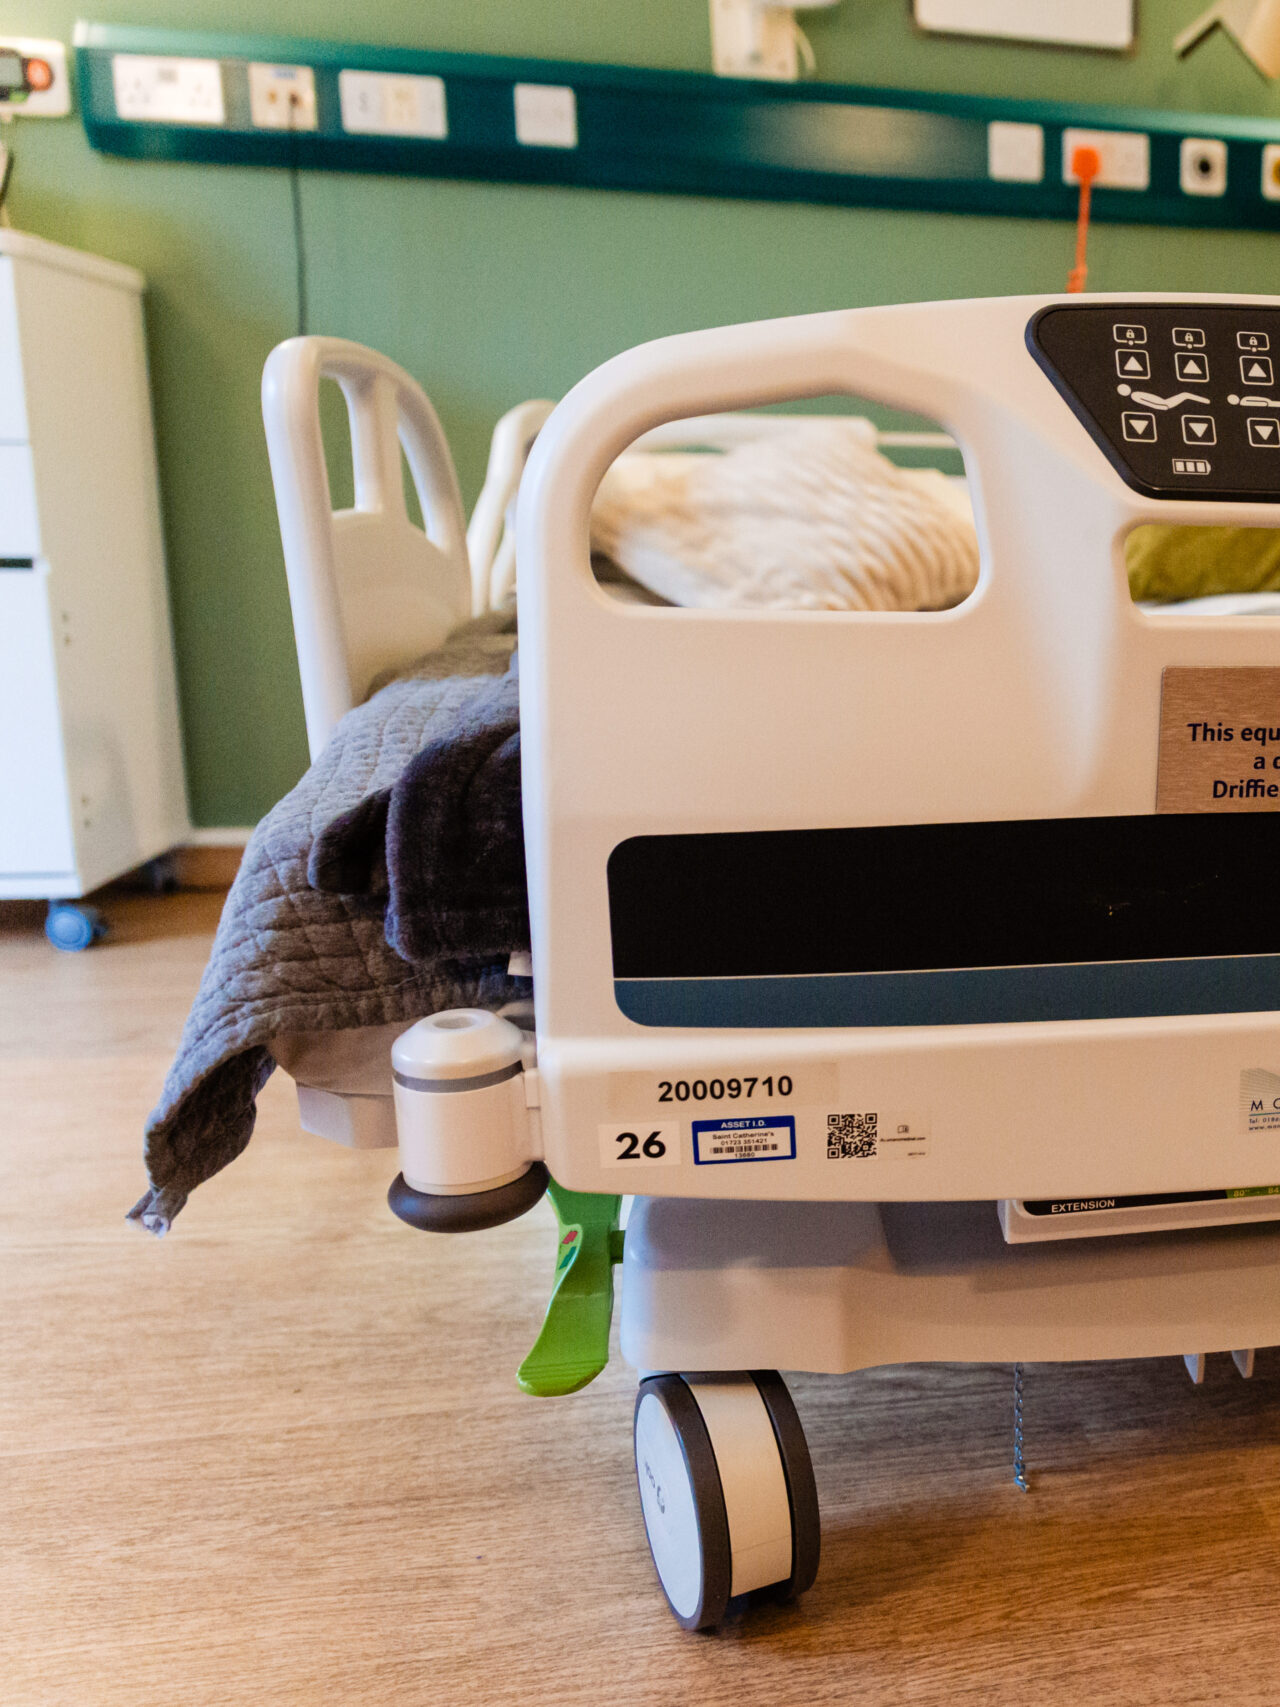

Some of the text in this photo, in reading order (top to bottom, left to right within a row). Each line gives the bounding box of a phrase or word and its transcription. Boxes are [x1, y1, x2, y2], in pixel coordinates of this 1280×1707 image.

[1187, 722, 1234, 742] This
[1253, 754, 1266, 770] a
[657, 1075, 794, 1103] 20009710
[720, 1121, 750, 1129] ASSET
[732, 1131, 775, 1139] Catherine's
[615, 1130, 667, 1161] 26
[1051, 1199, 1116, 1213] EXTENSION
